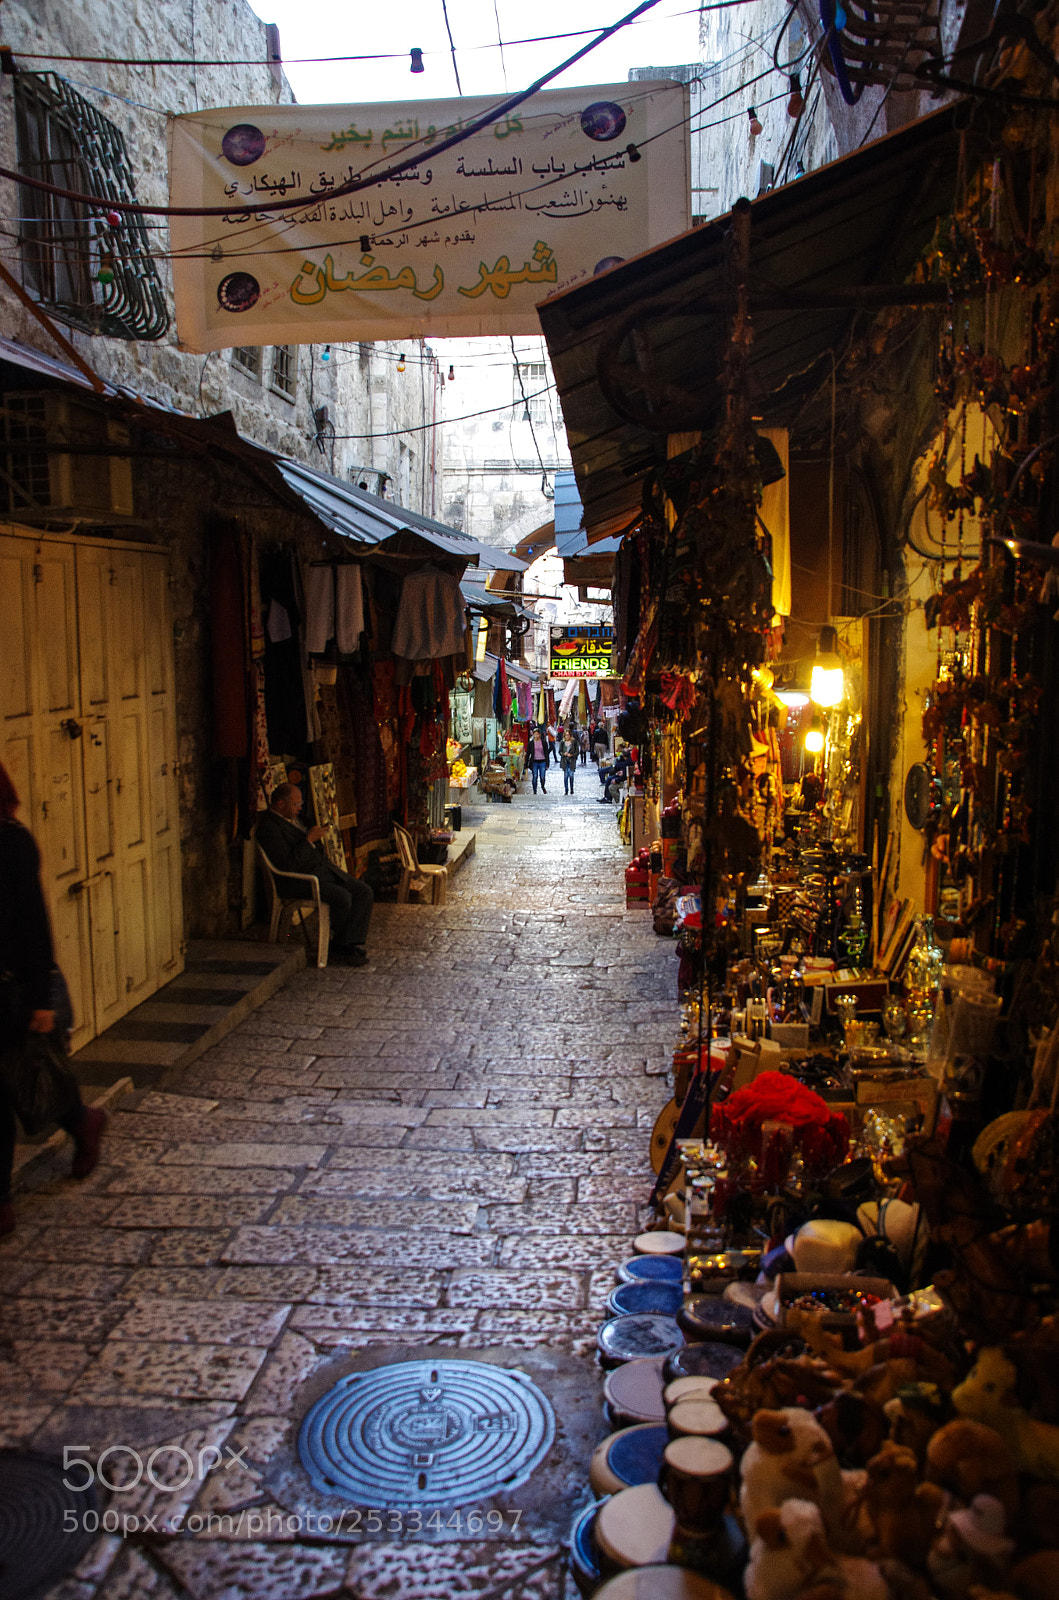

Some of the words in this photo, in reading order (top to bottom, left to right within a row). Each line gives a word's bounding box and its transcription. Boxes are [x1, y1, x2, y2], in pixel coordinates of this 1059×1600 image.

[320, 122, 374, 151] بخير
[494, 112, 524, 140] كل
[456, 156, 523, 178] السلسة
[532, 155, 566, 179] باب
[573, 151, 626, 177] شباب
[224, 170, 301, 199] الهيكاري
[370, 165, 433, 189] وشبب
[330, 200, 371, 224] البلدة
[431, 192, 471, 215] عامة
[473, 190, 522, 226] المسلم
[524, 189, 584, 217] الشعب
[370, 233, 409, 249] الرحمة
[414, 231, 440, 248] شهر
[444, 229, 476, 248] بقدوم
[290, 252, 444, 305] رمضان
[457, 240, 558, 299] شهر
[551, 657, 609, 670] FRIENDS
